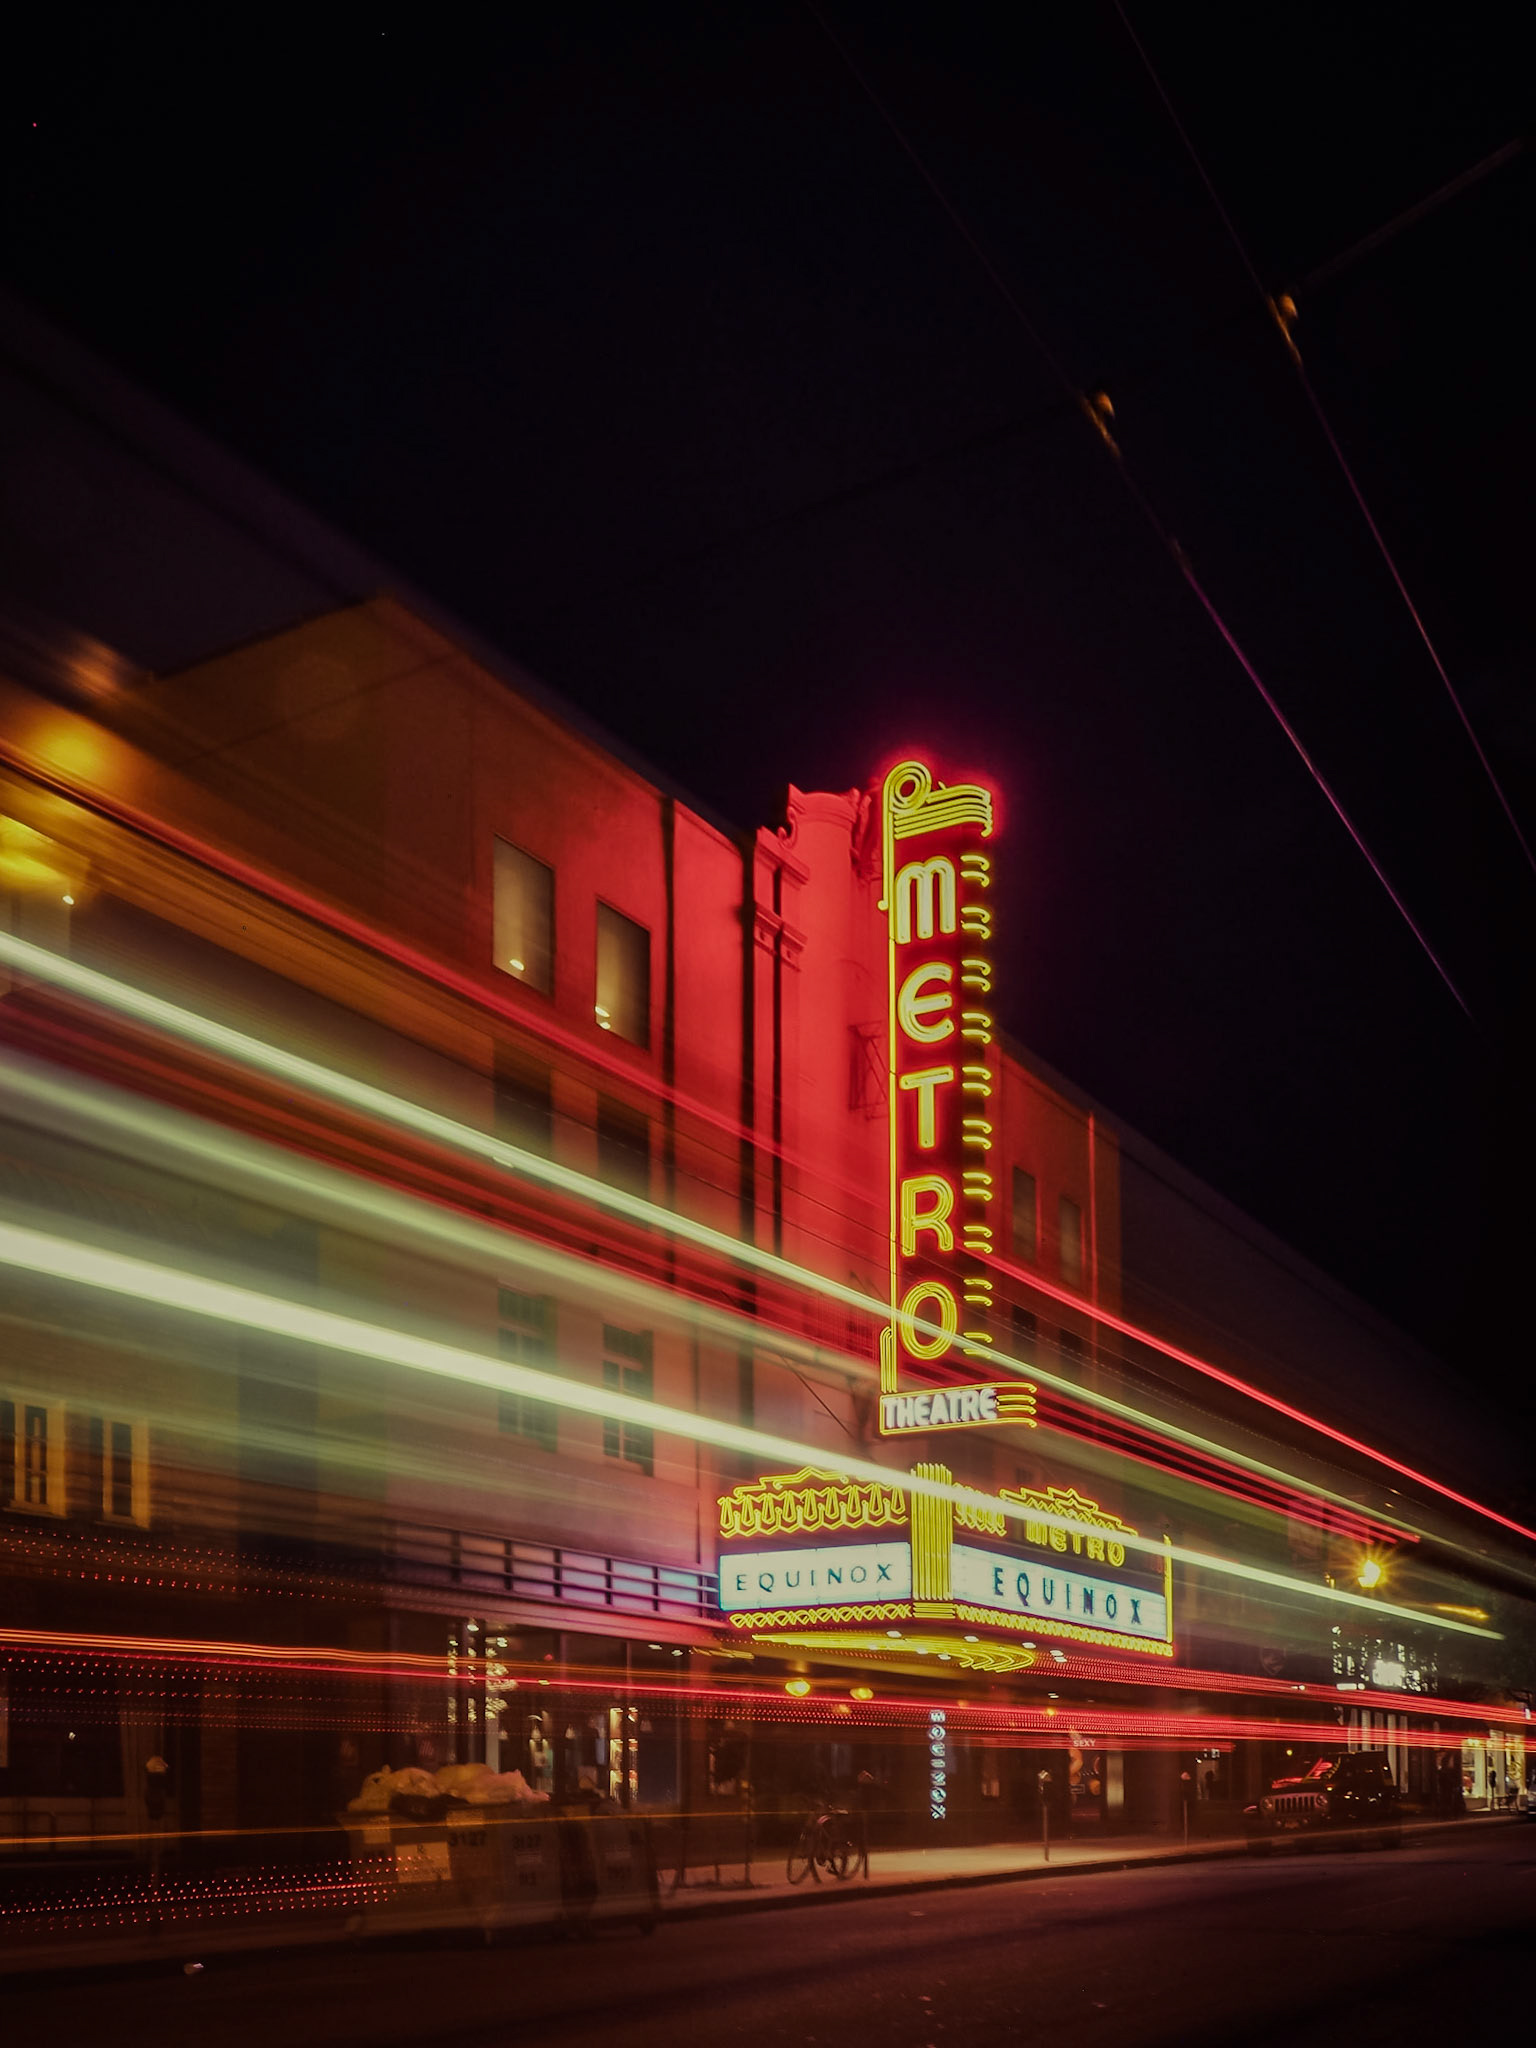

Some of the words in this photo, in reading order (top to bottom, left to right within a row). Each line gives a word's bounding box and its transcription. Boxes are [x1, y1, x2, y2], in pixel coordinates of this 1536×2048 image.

[895, 855, 957, 1361] METRO
[884, 1388, 998, 1429] THEATRE
[1026, 1517, 1125, 1567] METRO
[736, 1562, 894, 1593] EQUINOX
[994, 1566, 1142, 1626] EQUINOX
[1073, 1738, 1096, 1747] SEXY
